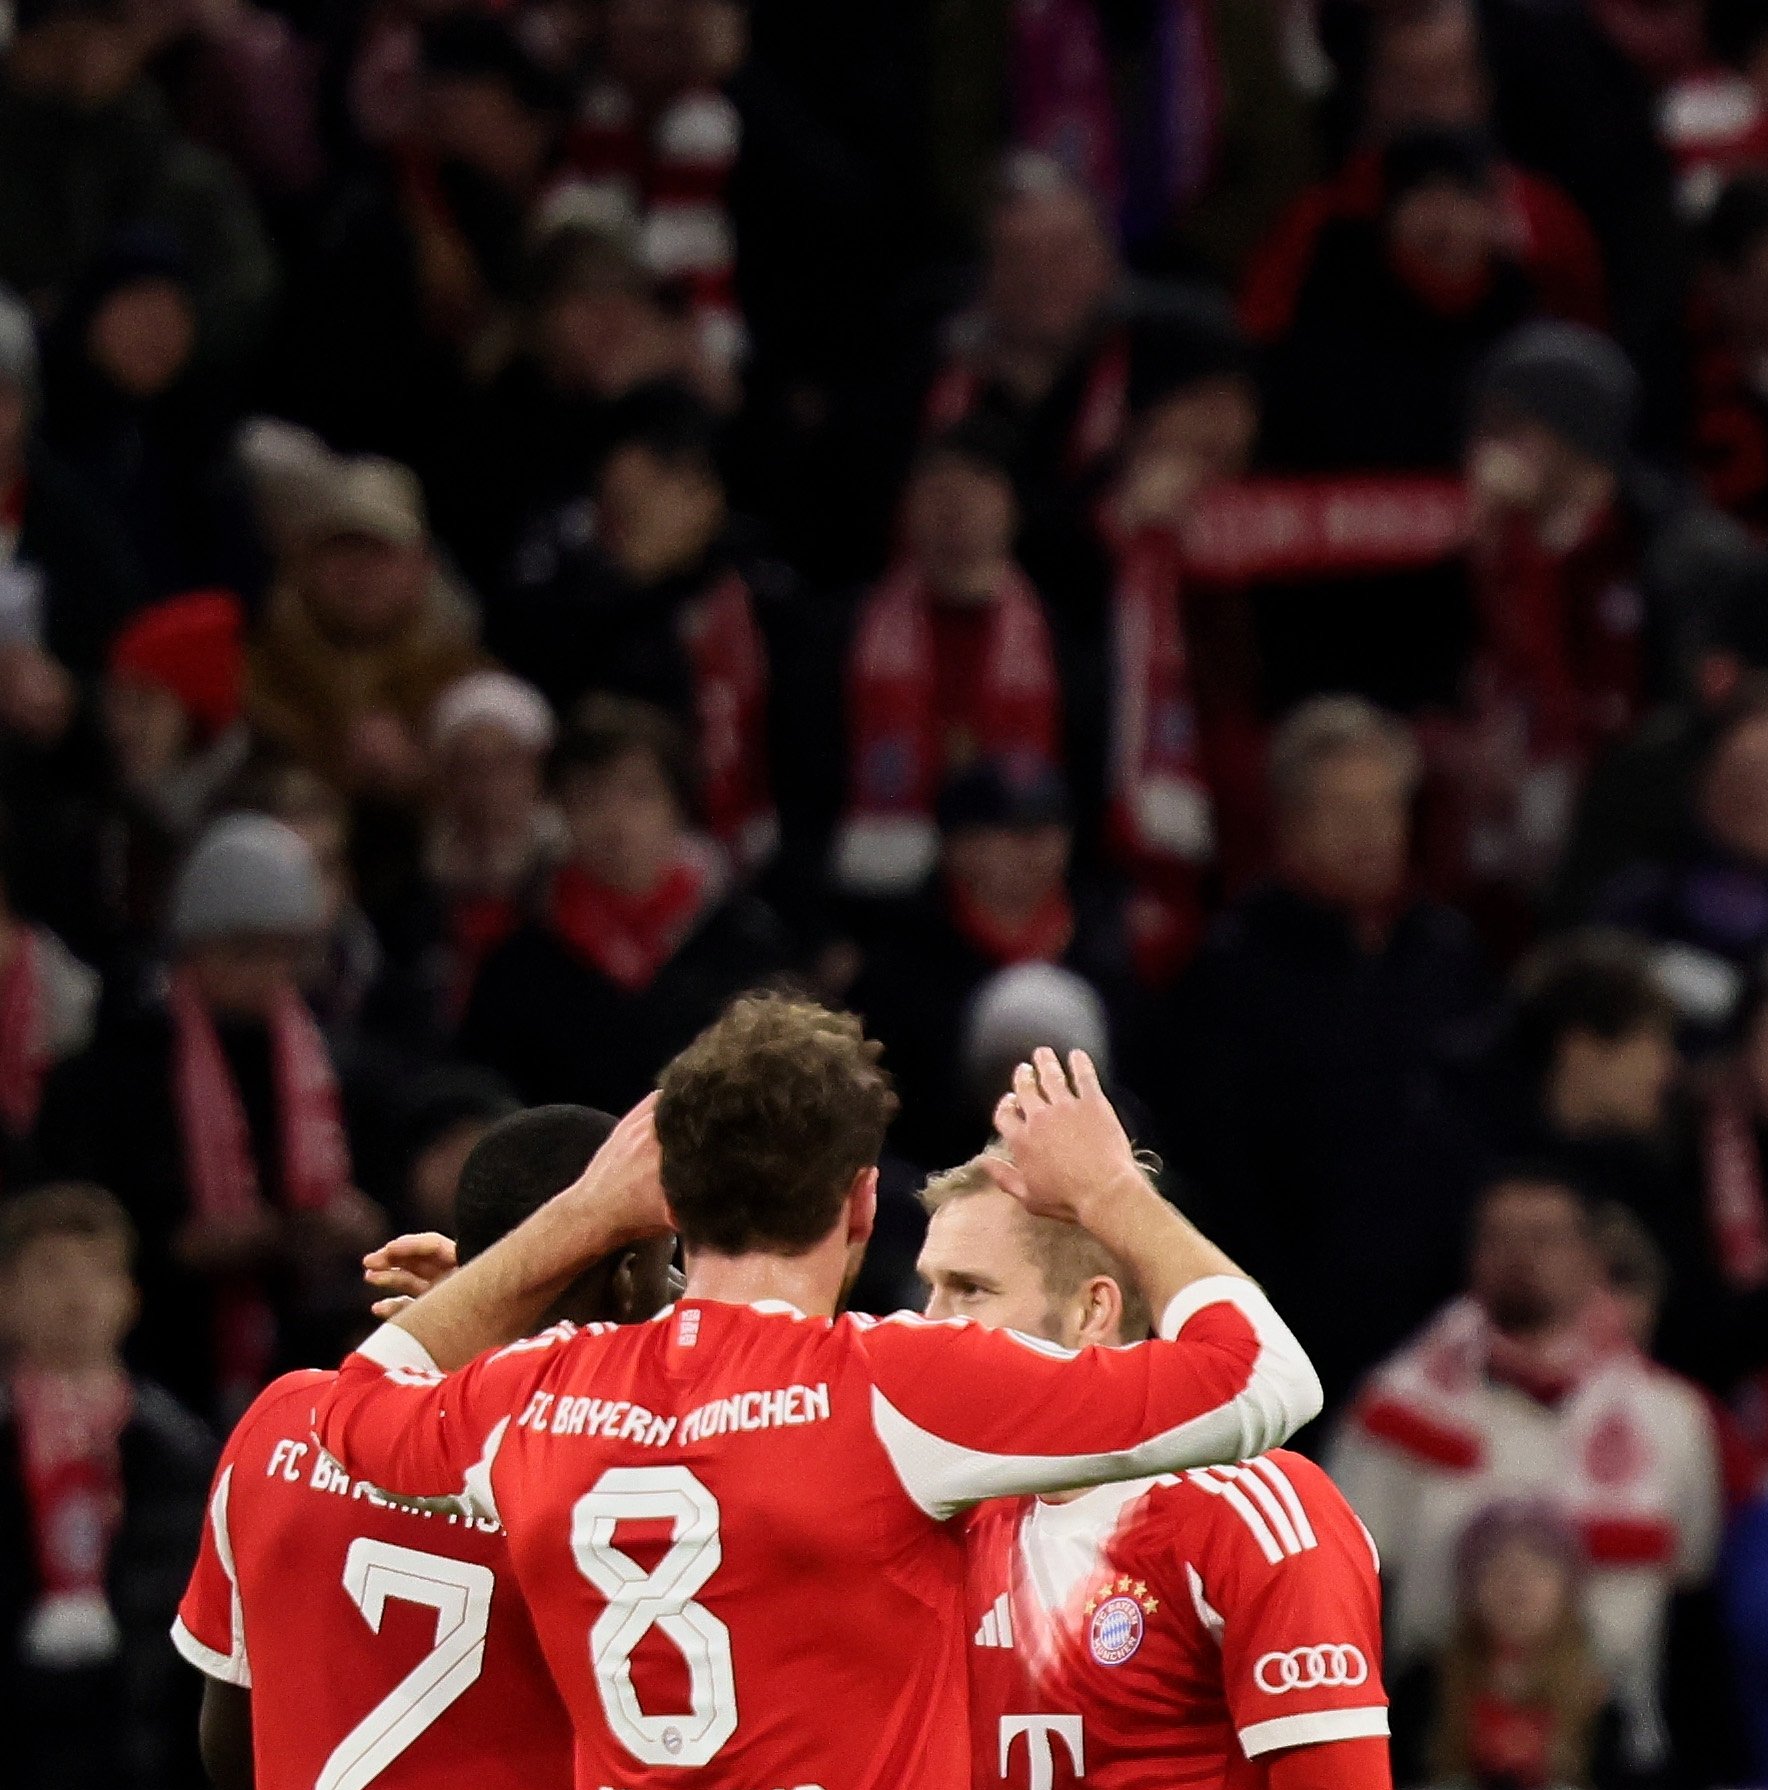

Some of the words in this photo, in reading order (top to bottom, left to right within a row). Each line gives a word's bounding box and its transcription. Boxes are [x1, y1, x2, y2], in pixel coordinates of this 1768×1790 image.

[518, 1391, 554, 1430] FC
[551, 1396, 678, 1447] BAYERN
[266, 1439, 307, 1481] FC
[570, 1465, 738, 1767] 8
